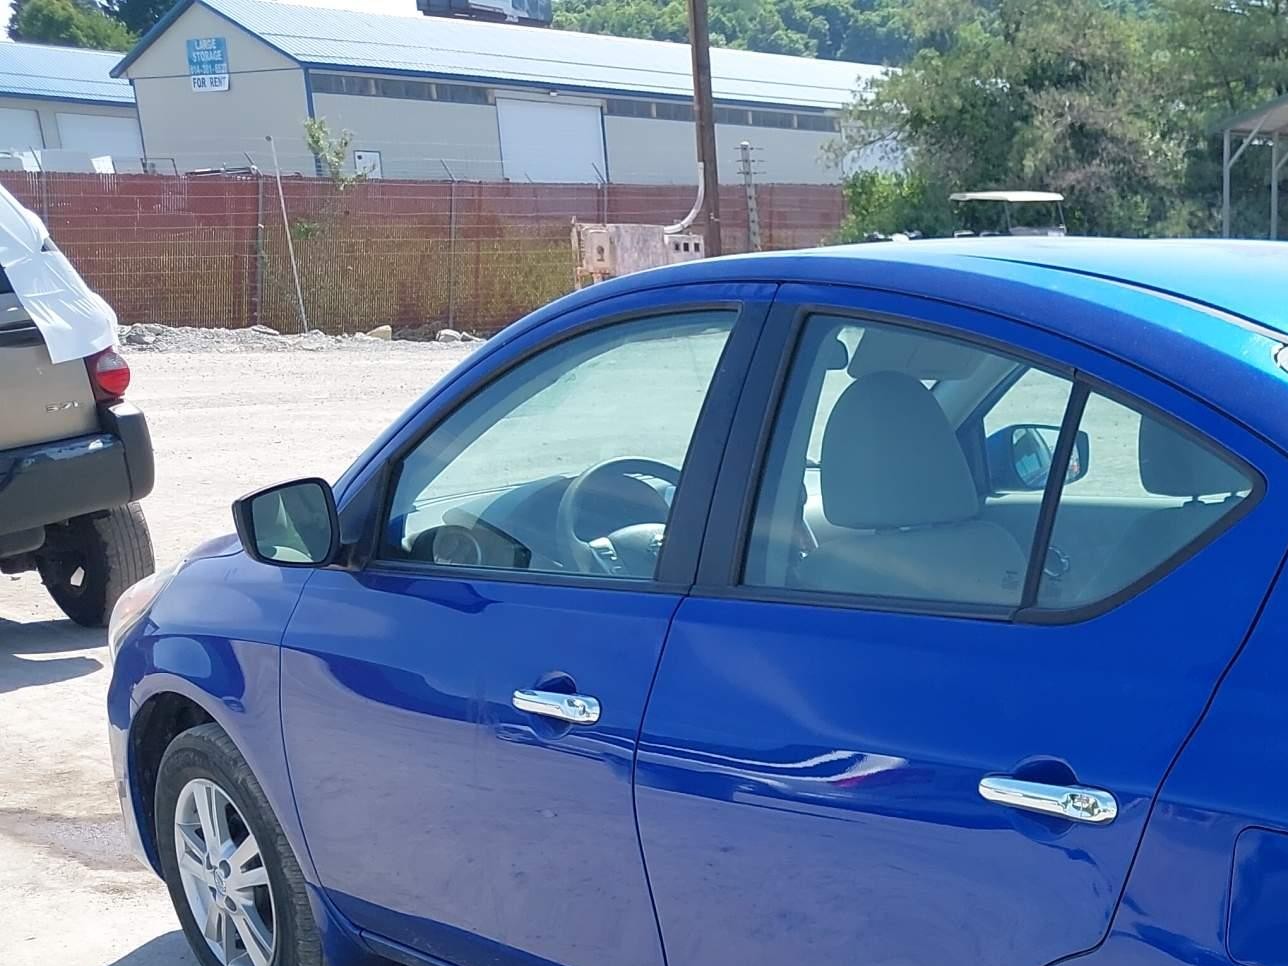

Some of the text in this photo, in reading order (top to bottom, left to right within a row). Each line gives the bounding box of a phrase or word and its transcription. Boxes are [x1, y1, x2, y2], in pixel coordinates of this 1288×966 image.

[194, 38, 217, 50] LARGE
[192, 50, 223, 62] STORAGE
[192, 75, 227, 88] FOR RENT
